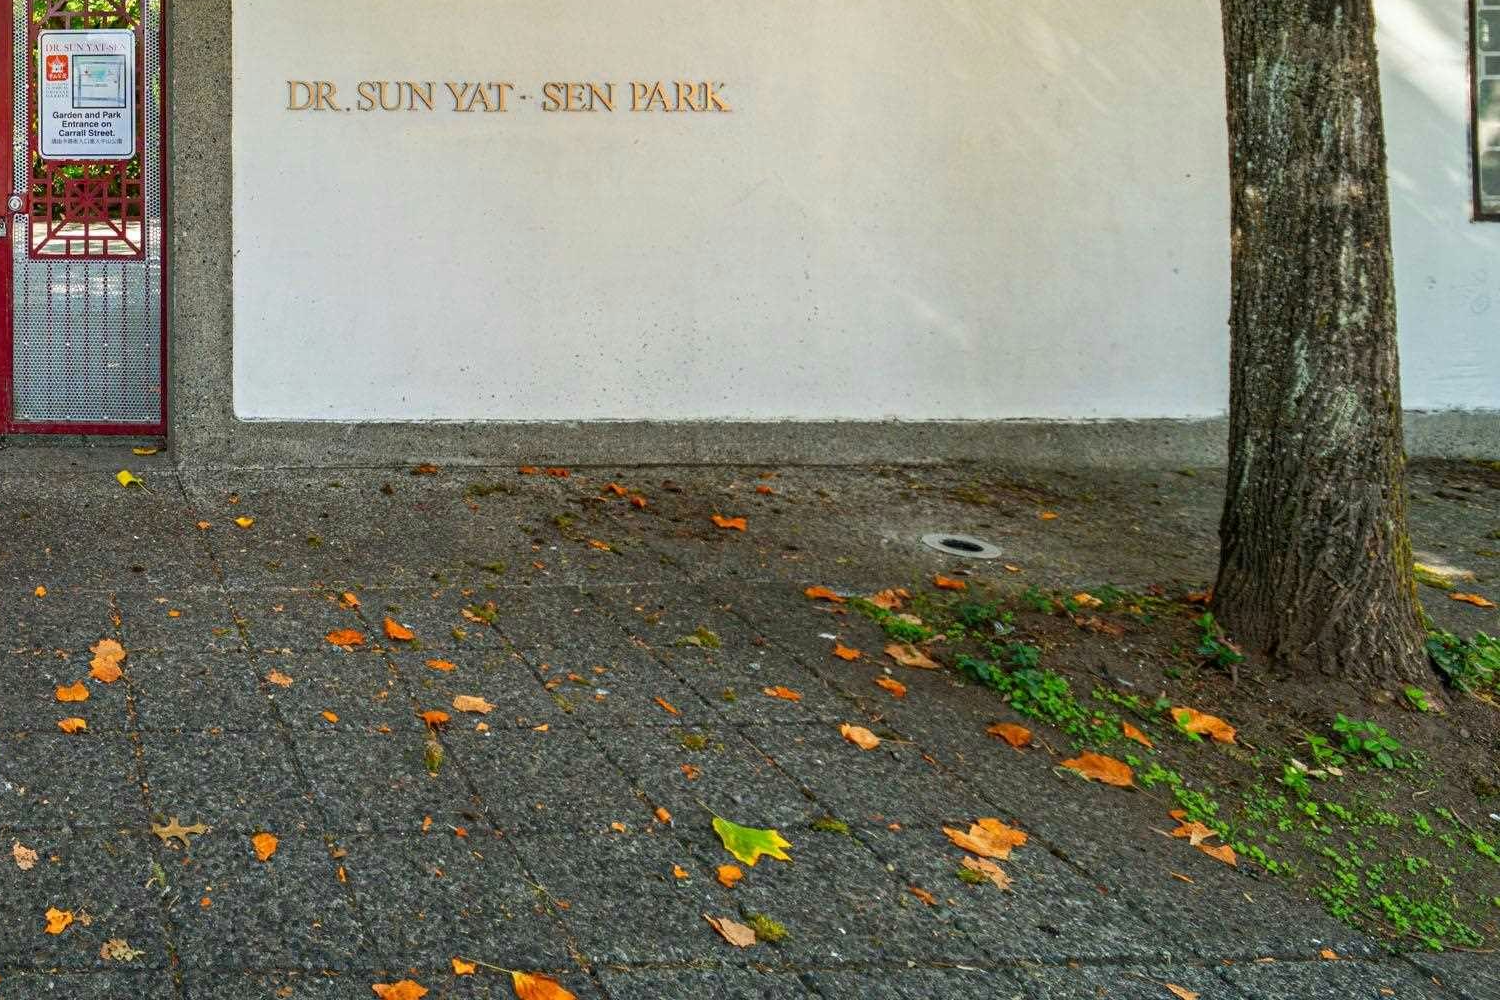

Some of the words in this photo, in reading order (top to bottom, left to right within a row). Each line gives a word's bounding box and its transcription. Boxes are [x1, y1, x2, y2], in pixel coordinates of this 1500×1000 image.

[286, 80, 351, 112] DR.
[356, 80, 437, 112] SUN
[628, 80, 732, 113] PARK
[52, 111, 82, 119] Garden
[85, 111, 100, 119] and
[102, 111, 122, 119] Park
[62, 120, 99, 128] Entrance
[58, 129, 86, 137] Carrall
[88, 129, 116, 137] Street.
